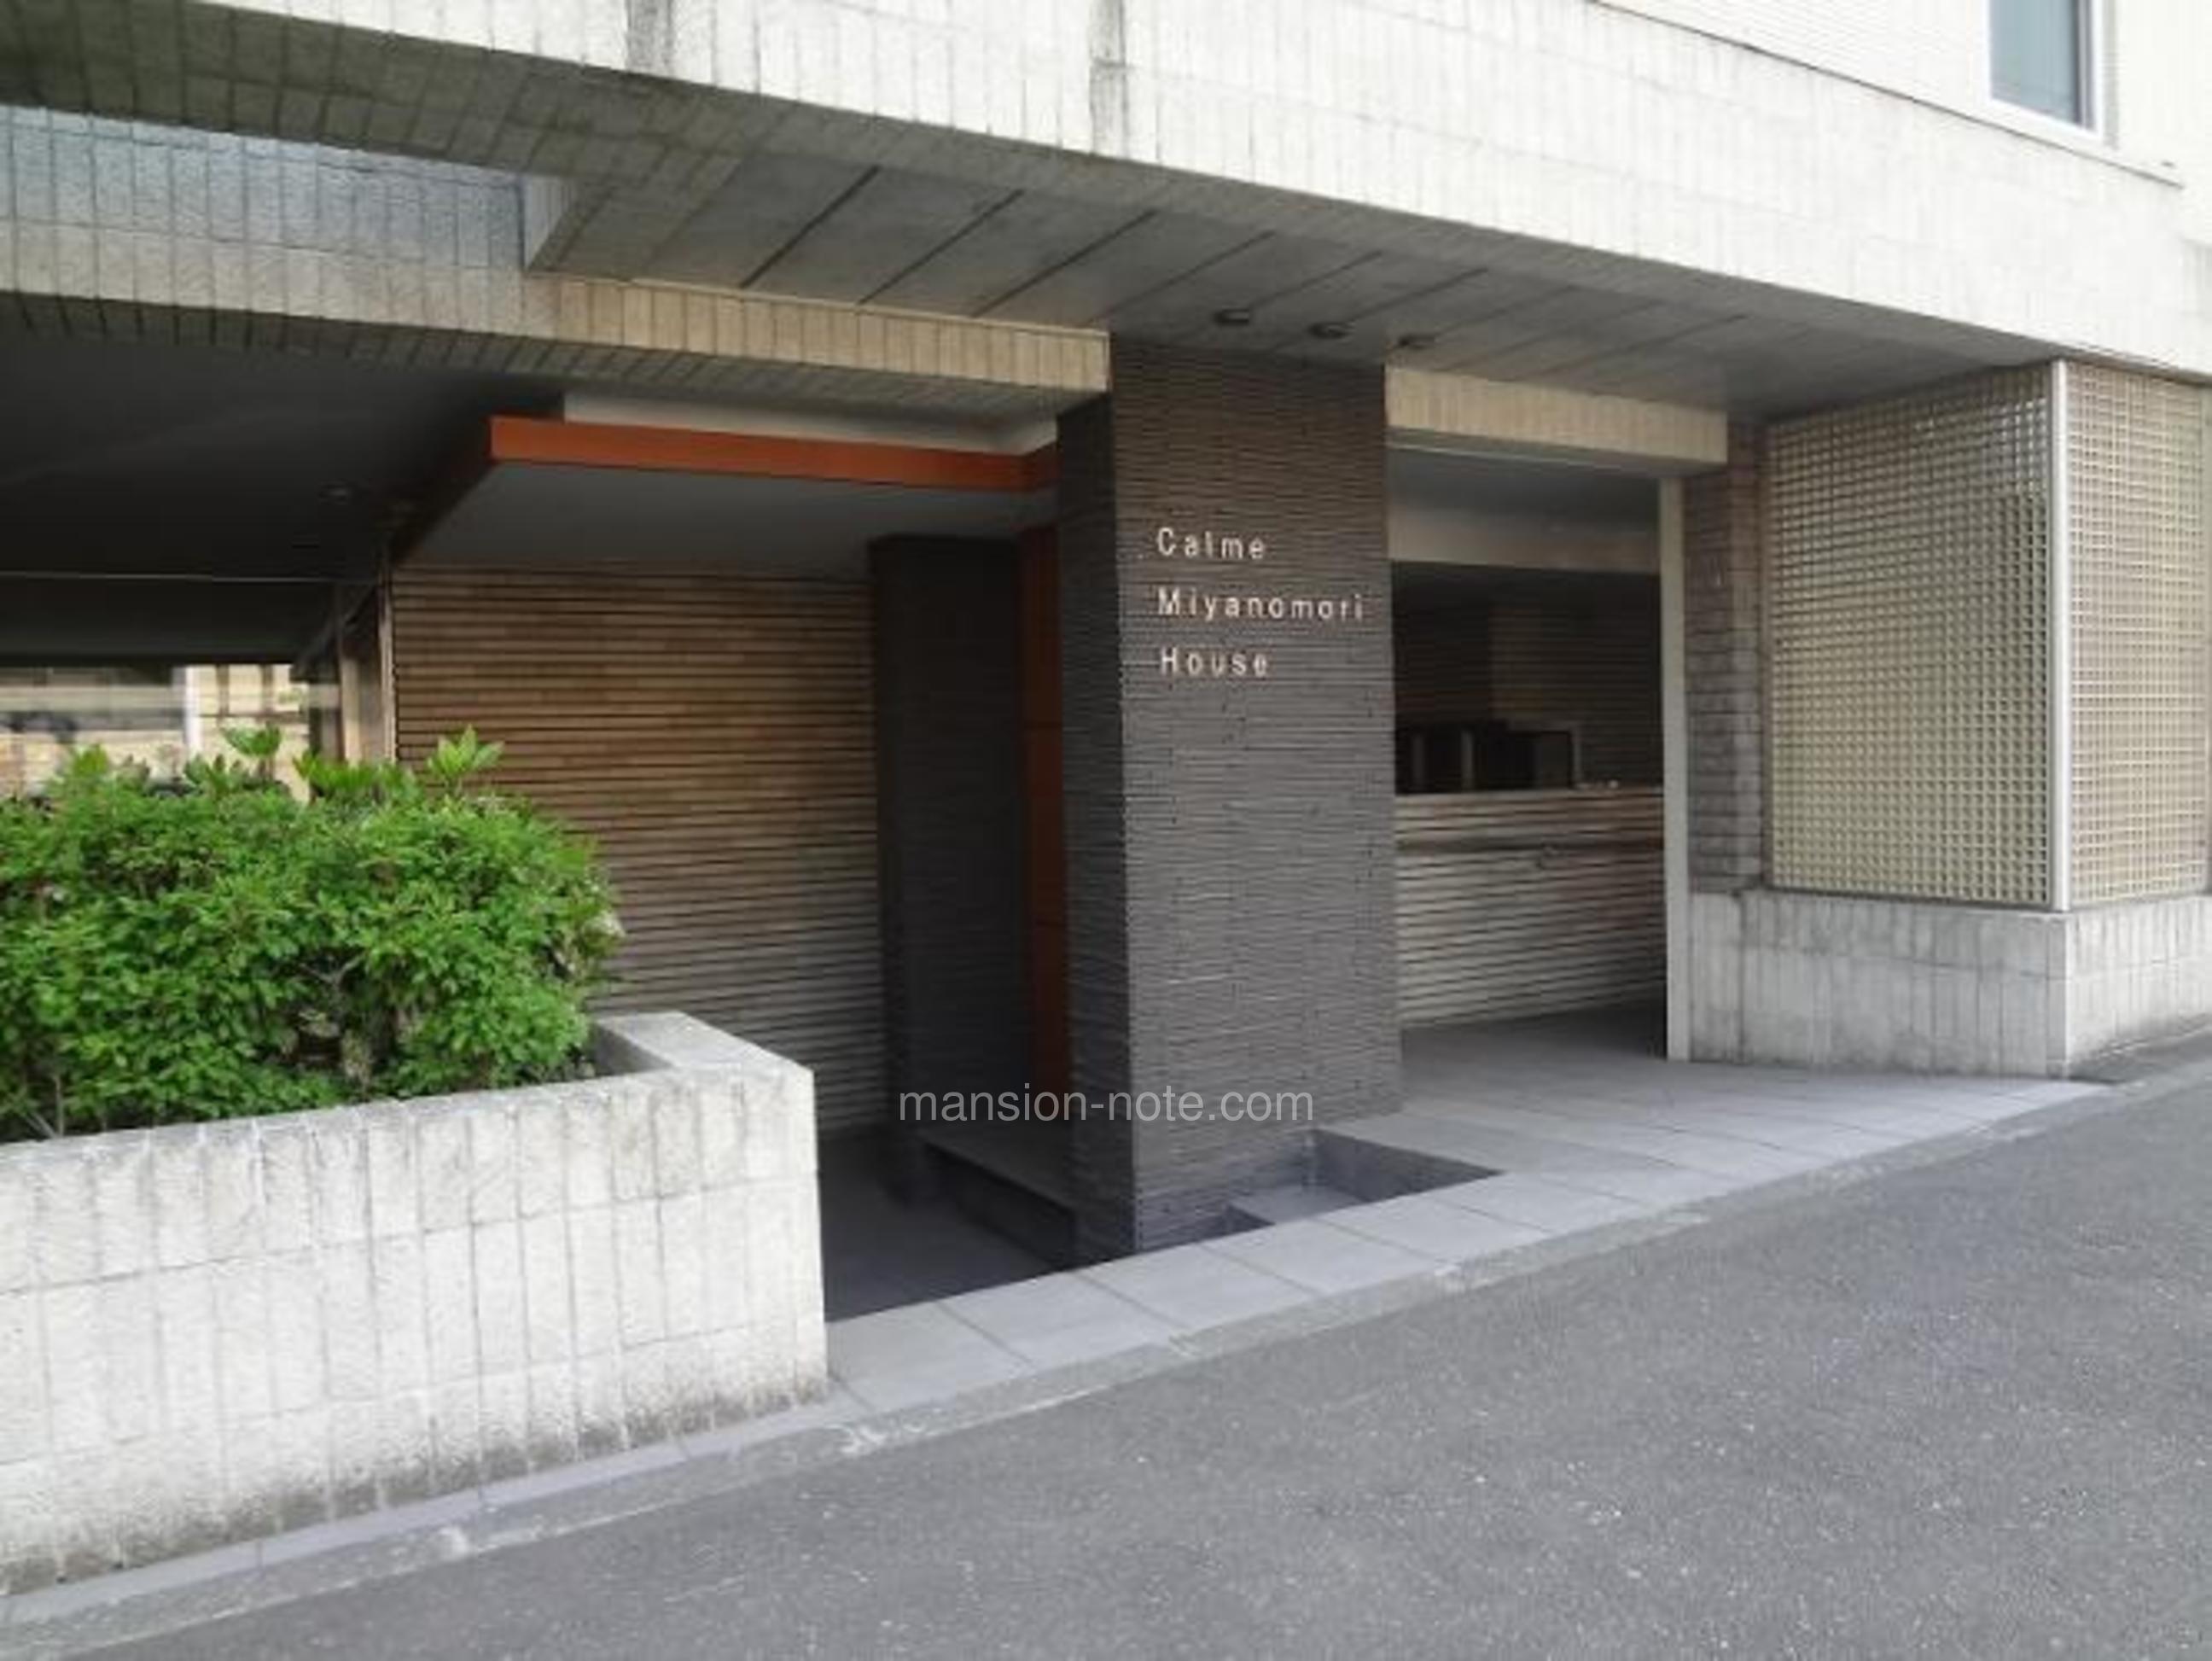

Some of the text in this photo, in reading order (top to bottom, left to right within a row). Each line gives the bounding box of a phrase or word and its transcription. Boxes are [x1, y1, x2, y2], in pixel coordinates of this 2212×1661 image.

[1156, 527, 1266, 559] Calme
[1157, 586, 1364, 621] Miyanomori
[1160, 645, 1268, 677] House
